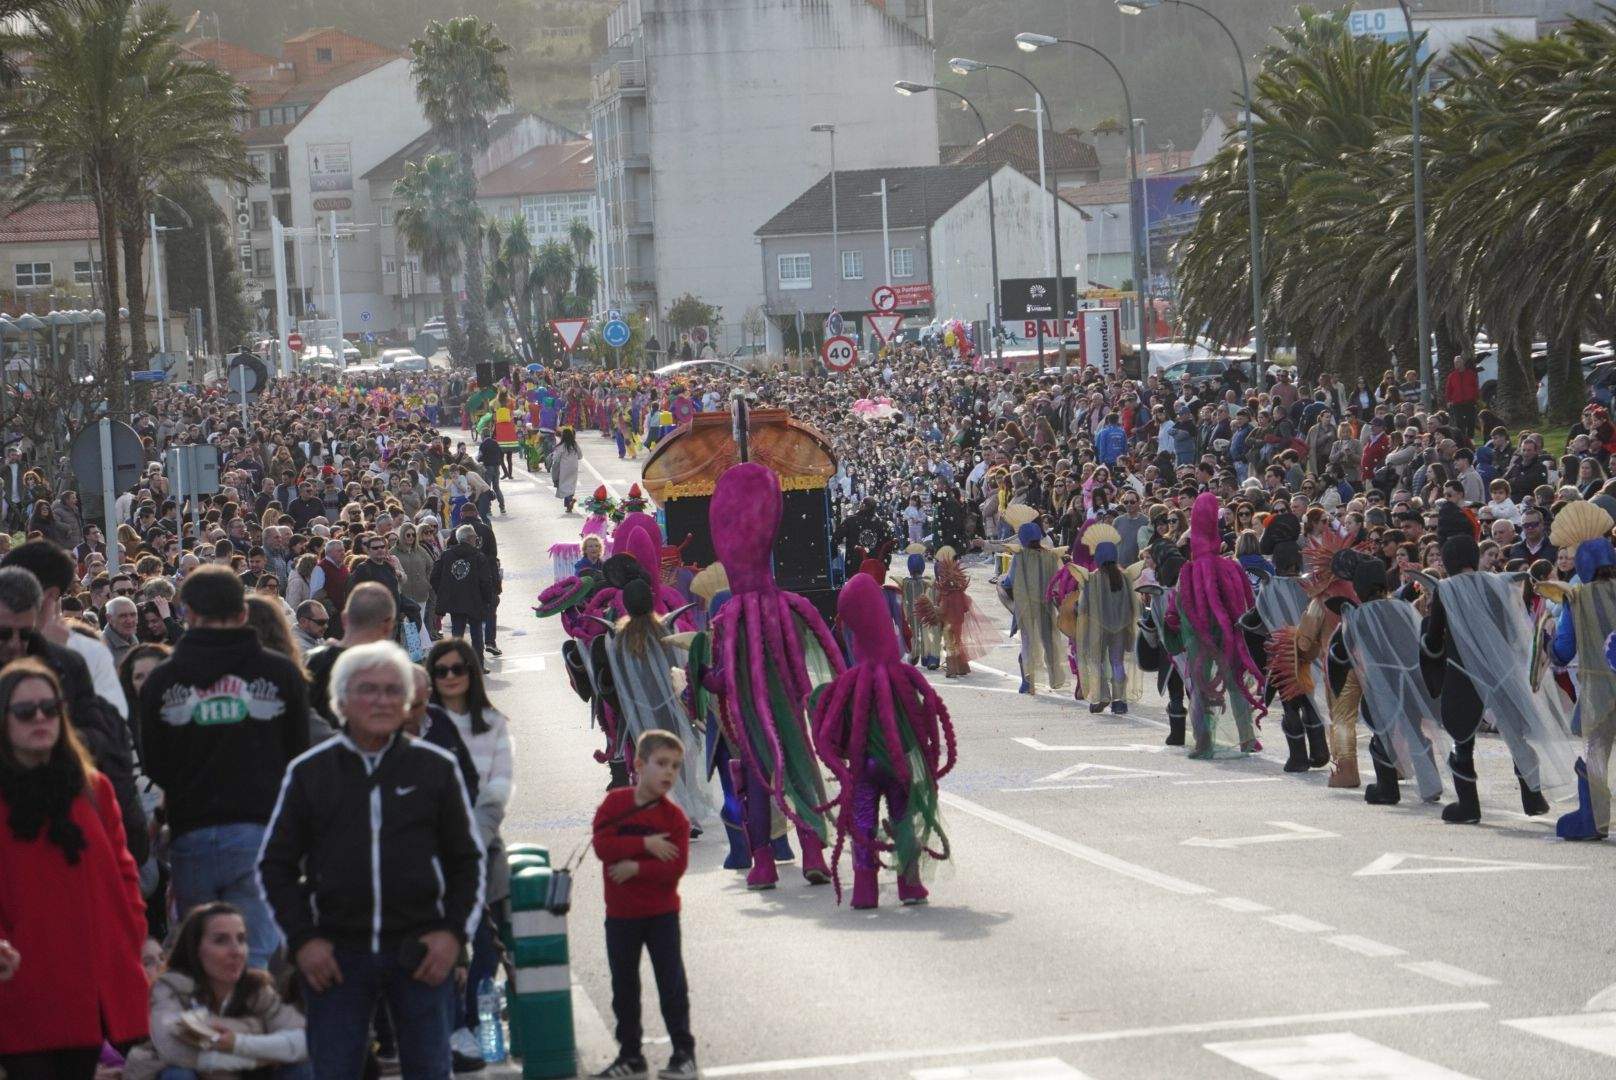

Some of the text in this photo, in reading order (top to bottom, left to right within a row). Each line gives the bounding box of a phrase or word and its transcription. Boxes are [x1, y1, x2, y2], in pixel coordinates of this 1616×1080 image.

[237, 198, 252, 272] HOTEL
[1024, 320, 1079, 338] BALTA
[1100, 314, 1110, 375] ntretendas
[830, 347, 850, 359] 40
